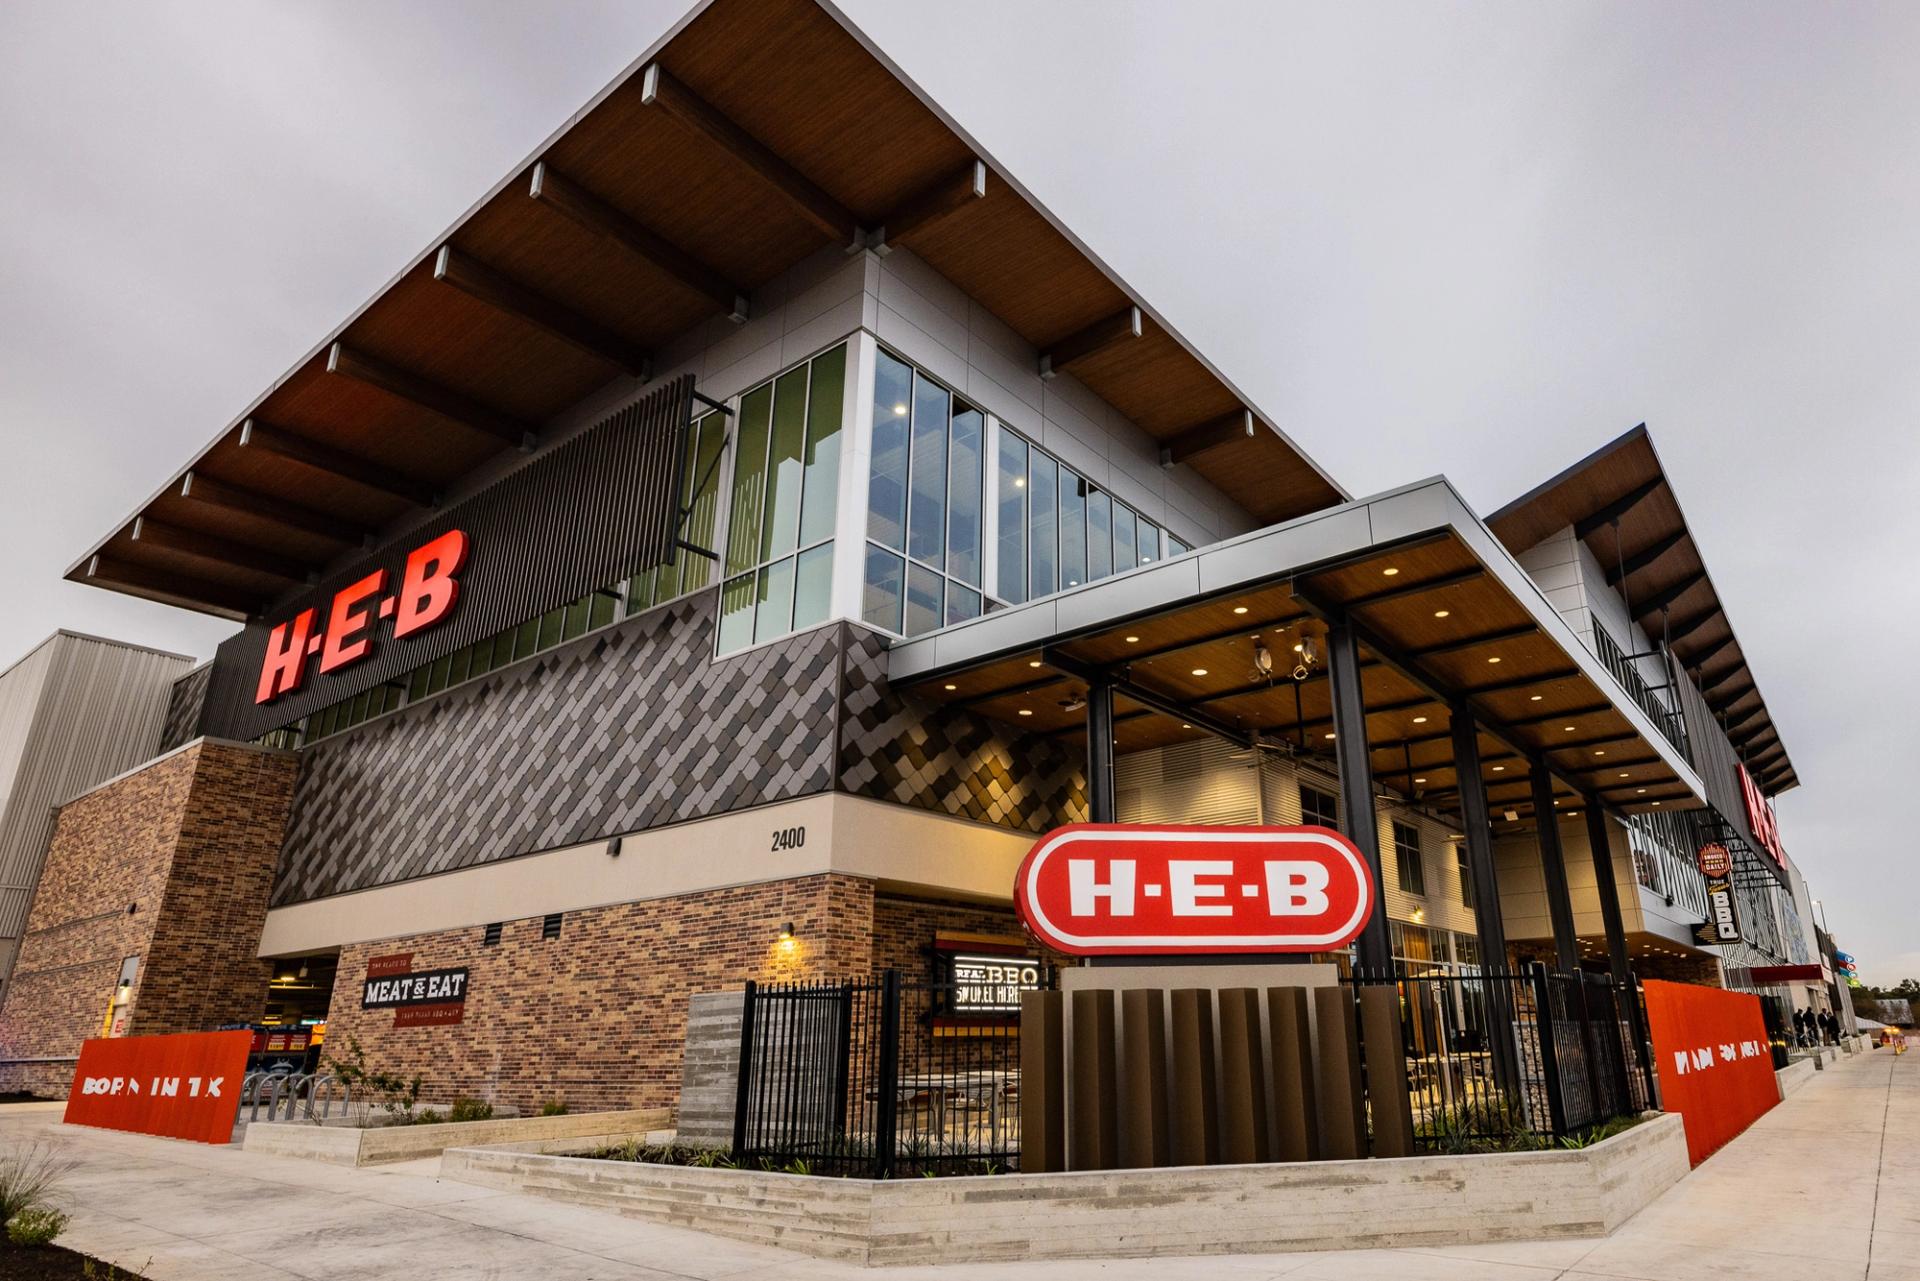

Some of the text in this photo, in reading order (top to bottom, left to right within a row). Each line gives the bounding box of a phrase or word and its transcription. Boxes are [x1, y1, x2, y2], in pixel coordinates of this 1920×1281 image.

[255, 529, 468, 705] H-E-B
[771, 826, 805, 852] 2400
[1705, 863, 1726, 871] DAILY
[1068, 859, 1330, 917] H-E-B
[1712, 891, 1739, 939] BBQ
[365, 979, 413, 1003] MEAT
[426, 973, 465, 998] EAT
[986, 966, 1038, 984] BBQ
